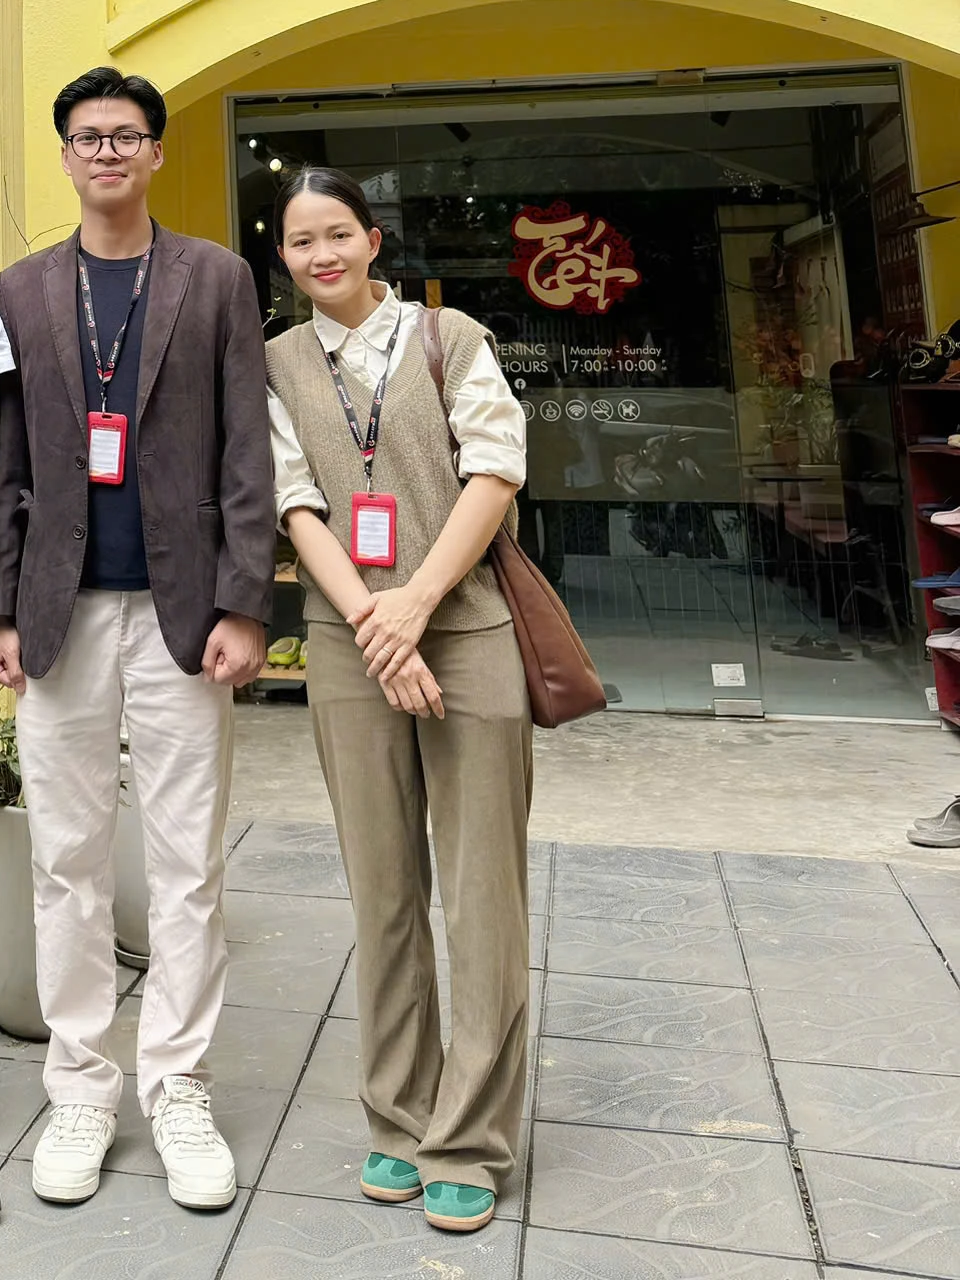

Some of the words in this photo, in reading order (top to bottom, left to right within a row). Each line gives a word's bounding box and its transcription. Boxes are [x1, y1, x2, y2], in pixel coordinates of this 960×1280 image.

[495, 343, 547, 356] PENING
[570, 344, 613, 358] Monday
[622, 344, 662, 357] Sunday
